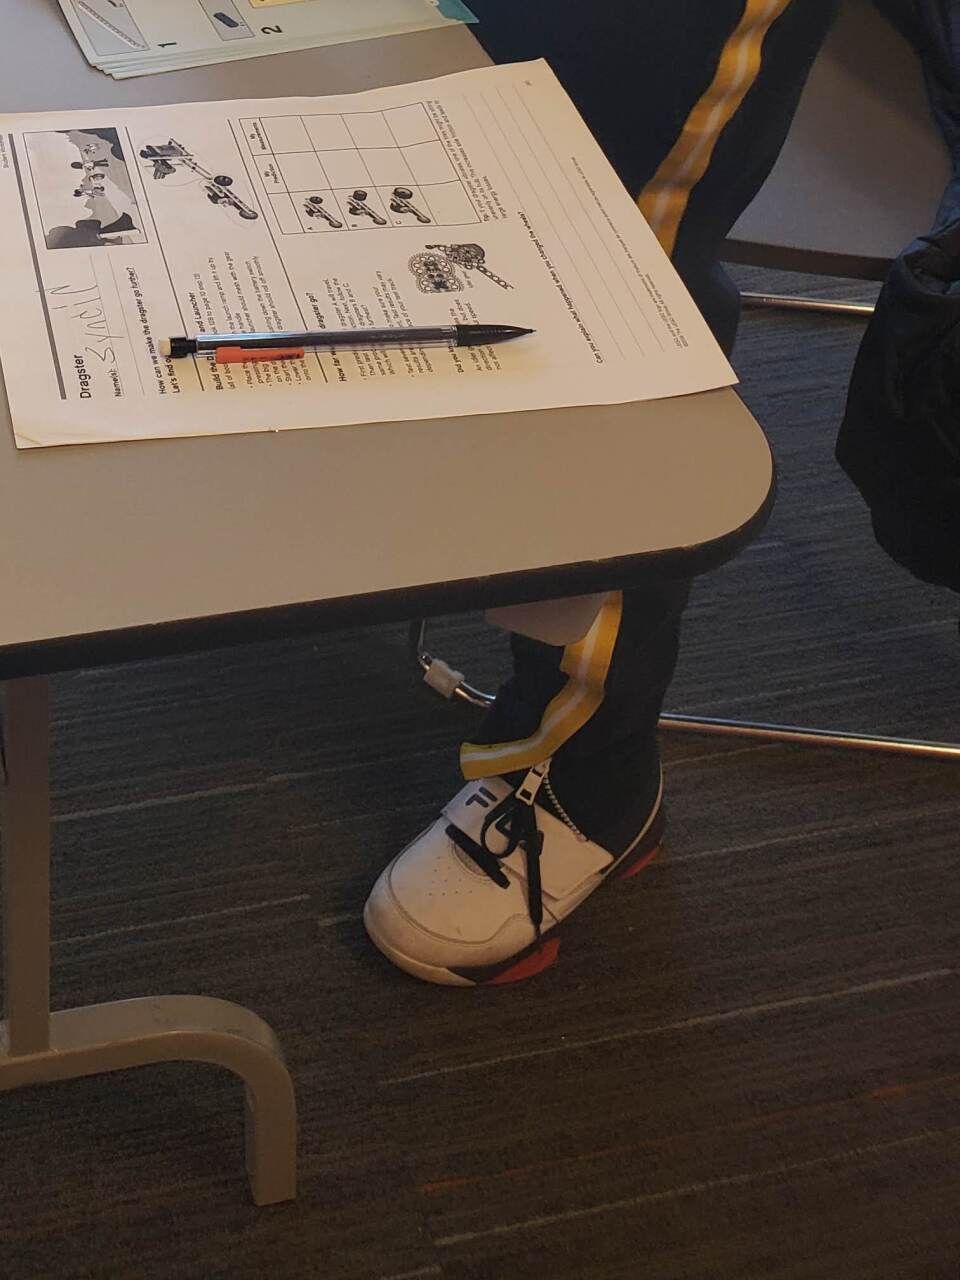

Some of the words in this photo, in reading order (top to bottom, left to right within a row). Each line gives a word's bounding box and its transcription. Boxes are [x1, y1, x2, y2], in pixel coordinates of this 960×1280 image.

[260, 23, 284, 35] 2
[157, 41, 178, 49] 1
[517, 211, 531, 229] wheels?
[531, 239, 547, 259] changed
[125, 267, 139, 288] further?
[549, 270, 560, 282] when
[555, 284, 573, 309] happened
[135, 298, 147, 323] dragster
[188, 292, 201, 319] Launcher
[311, 304, 325, 329] dragster
[570, 310, 580, 322] what
[142, 324, 150, 335] the
[195, 320, 205, 332] and
[578, 323, 591, 341] explain
[145, 336, 155, 353] make
[593, 352, 603, 363] Can
[73, 354, 91, 398] Dragster
[153, 366, 162, 377] can
[165, 363, 174, 375] find
[282, 369, 291, 381] Start
[291, 365, 301, 381] Lower
[302, 368, 311, 380] onto
[336, 367, 346, 381] How
[357, 365, 366, 376] First
[211, 373, 223, 389] Build
[244, 369, 252, 384] Place
[158, 380, 166, 394] How
[169, 377, 180, 392] Let's
